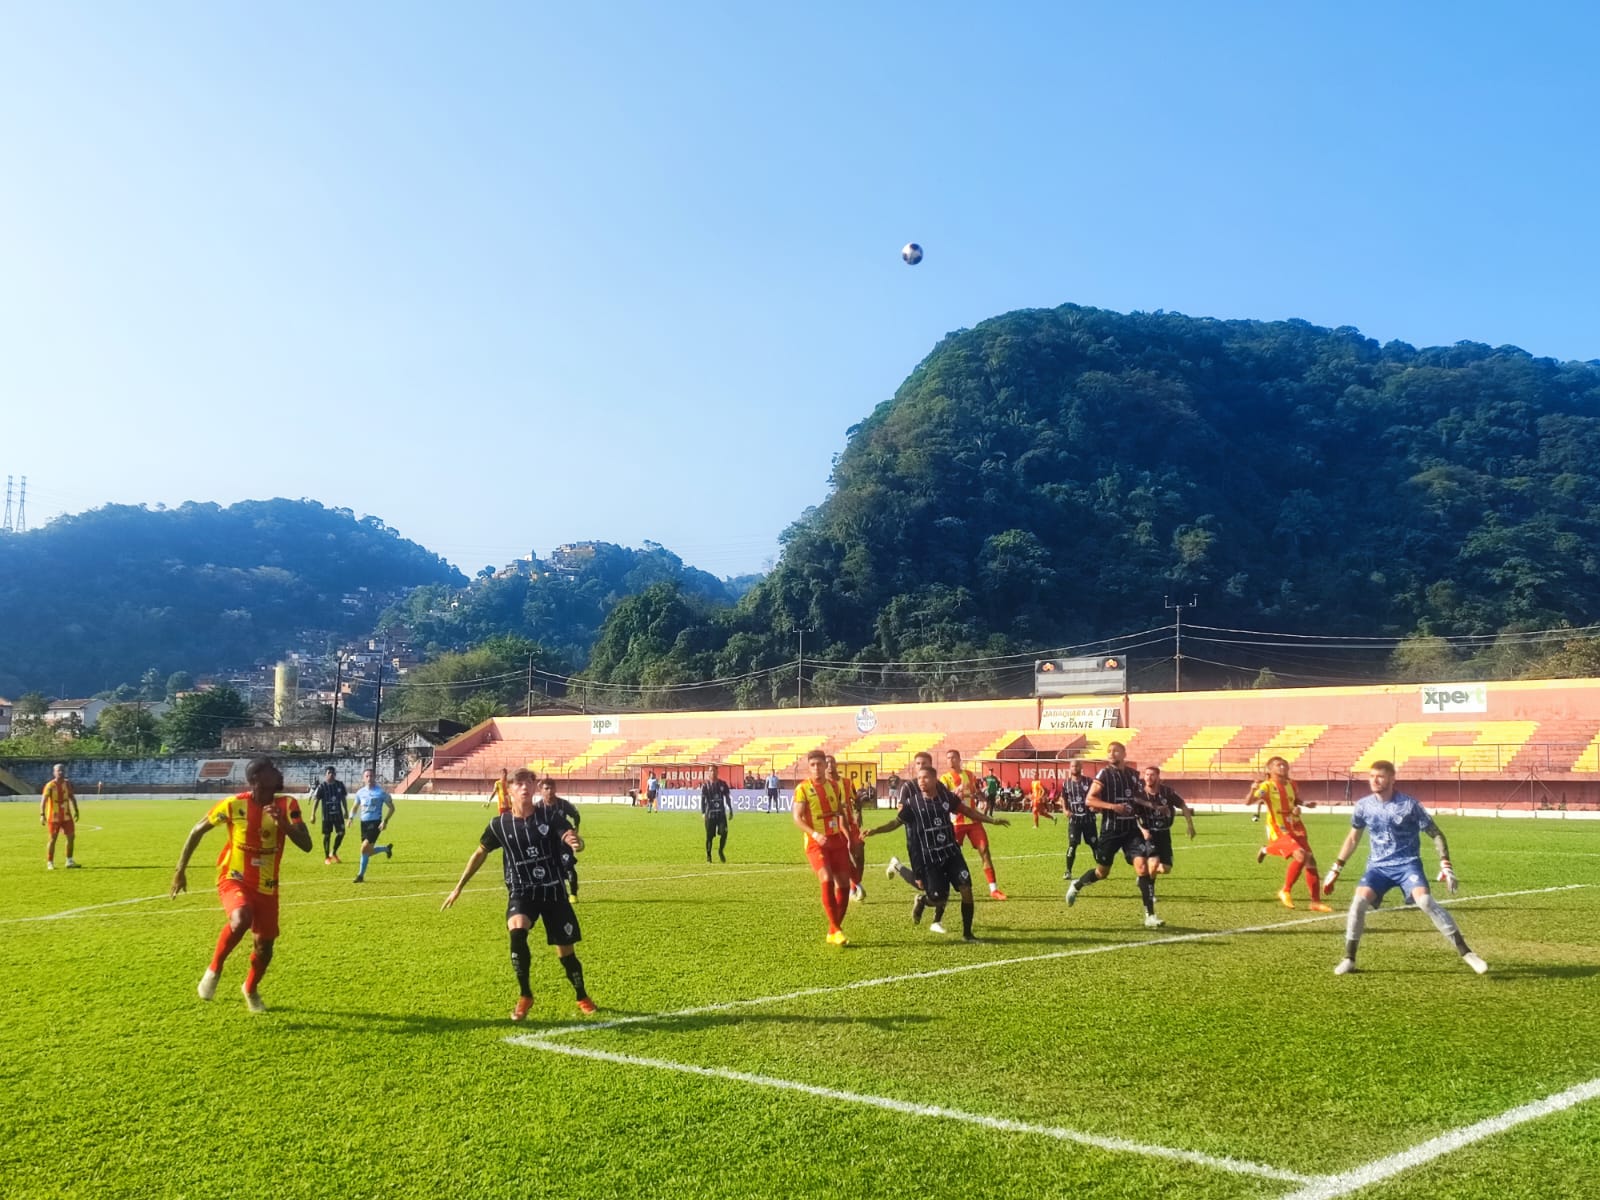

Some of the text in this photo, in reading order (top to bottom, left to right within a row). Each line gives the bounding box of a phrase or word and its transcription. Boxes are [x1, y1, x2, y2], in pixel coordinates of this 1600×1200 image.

[1050, 720, 1094, 729] VISITANTE
[663, 771, 714, 781] ABAQUAR
[1019, 767, 1083, 779] VISITANT
[660, 795, 703, 810] PAULIST
